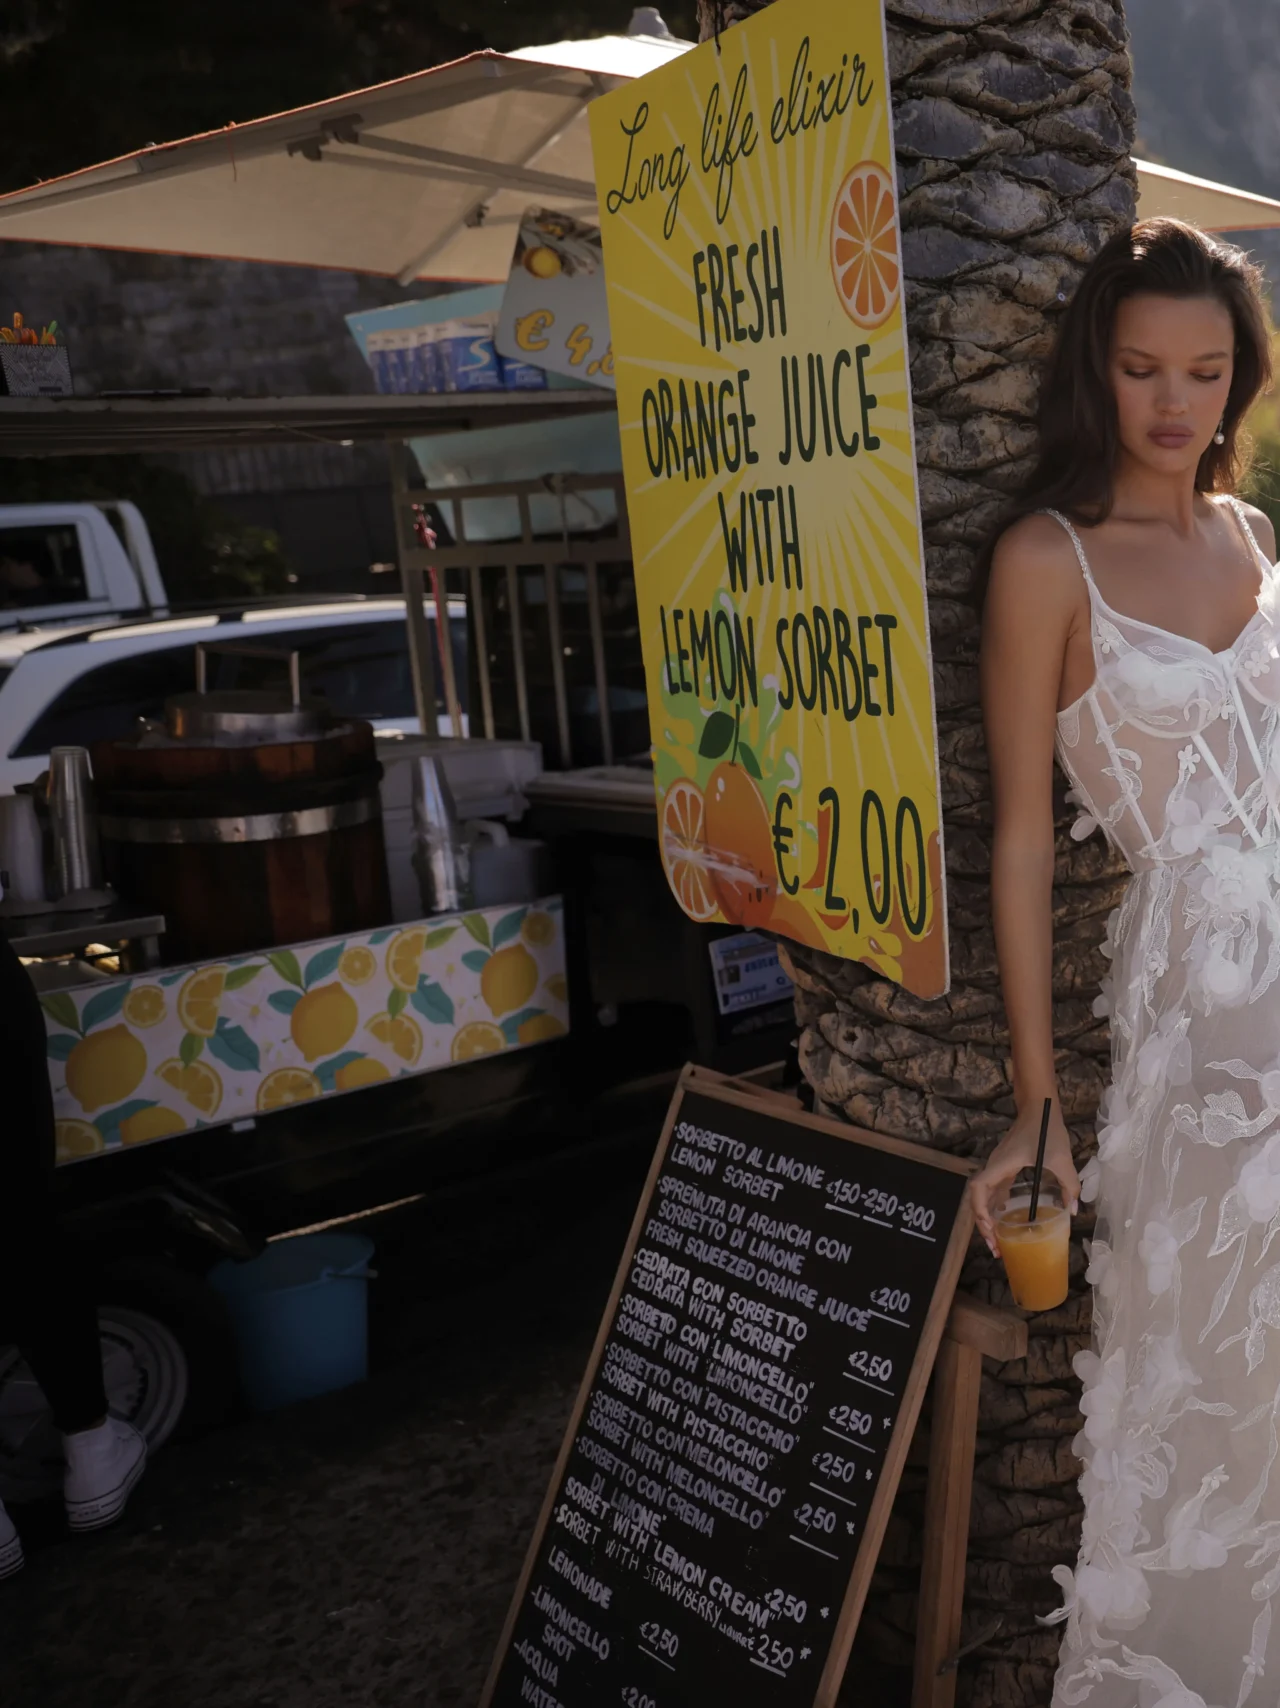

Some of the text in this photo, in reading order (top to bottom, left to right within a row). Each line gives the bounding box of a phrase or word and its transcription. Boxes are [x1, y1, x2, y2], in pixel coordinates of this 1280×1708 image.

[606, 36, 874, 240] Long life elixir
[693, 226, 787, 352] FRESH
[642, 343, 881, 482] ORANGE JUICE
[718, 485, 804, 593] WITH
[660, 604, 898, 722] LEMON SORBET
[671, 1143, 785, 1202] LEMON SORBET
[676, 1121, 747, 1161] SORBETTO
[746, 1146, 763, 1169] AL
[766, 1152, 826, 1190] LIMONE
[657, 1198, 807, 1276] SORBETTO DI LIMONE
[659, 1175, 853, 1265] SPREMUTA DI ARANCIA CON
[636, 1247, 808, 1342] CEDRATA CON SORBETTO
[645, 1218, 872, 1333] FRESH SQUEEZED ORANGE JUICE
[616, 1313, 663, 1351] SORBET
[663, 1339, 700, 1374] WITH
[631, 1266, 797, 1363] CEDRATA WITH SORBET
[680, 1324, 710, 1354] CON
[602, 1360, 647, 1402] SORBET
[646, 1387, 681, 1424] WITH
[607, 1341, 672, 1388] SORBETTO
[672, 1376, 703, 1407] CON
[586, 1408, 632, 1451] SORBET
[630, 1437, 666, 1475] WITH
[592, 1389, 654, 1439] SORBETTO
[655, 1426, 686, 1456] CON
[577, 1434, 638, 1489] SORBETTO
[636, 1474, 668, 1508] CON
[590, 1471, 607, 1496] DI
[565, 1475, 612, 1521] SORBET
[613, 1511, 650, 1555] WITH
[548, 1544, 614, 1611] LEMONADE
[556, 1503, 602, 1545] SORBET
[604, 1539, 641, 1573] WITH
[643, 1563, 723, 1629] STRAWBERRY
[541, 1623, 577, 1663] SHOT
